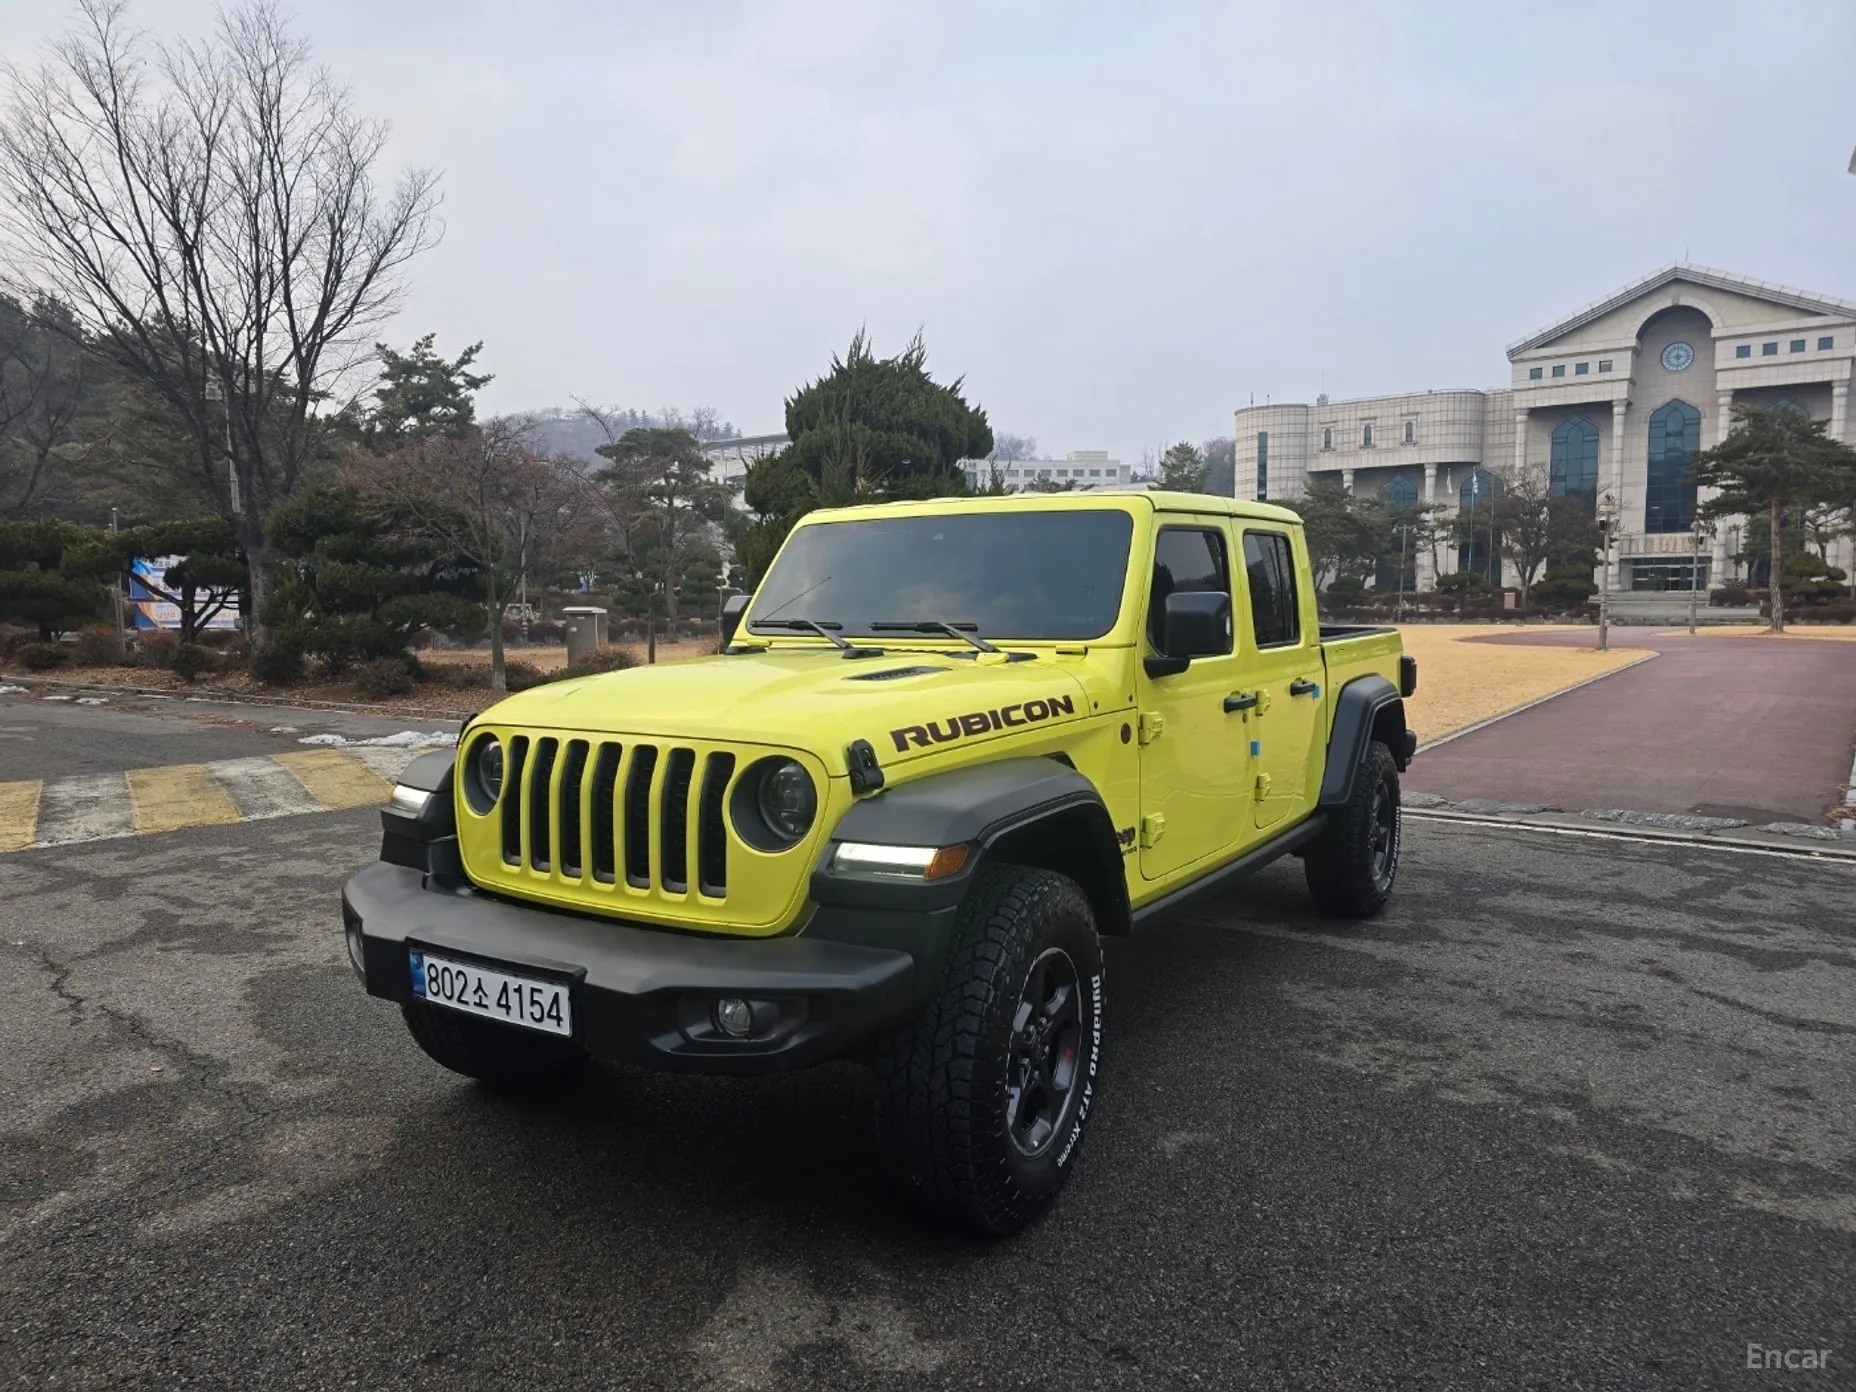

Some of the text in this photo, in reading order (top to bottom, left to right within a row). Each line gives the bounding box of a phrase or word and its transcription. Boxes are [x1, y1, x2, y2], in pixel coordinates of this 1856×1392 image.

[889, 694, 1075, 753] RUBICON
[427, 963, 564, 1027] 802소 4154
